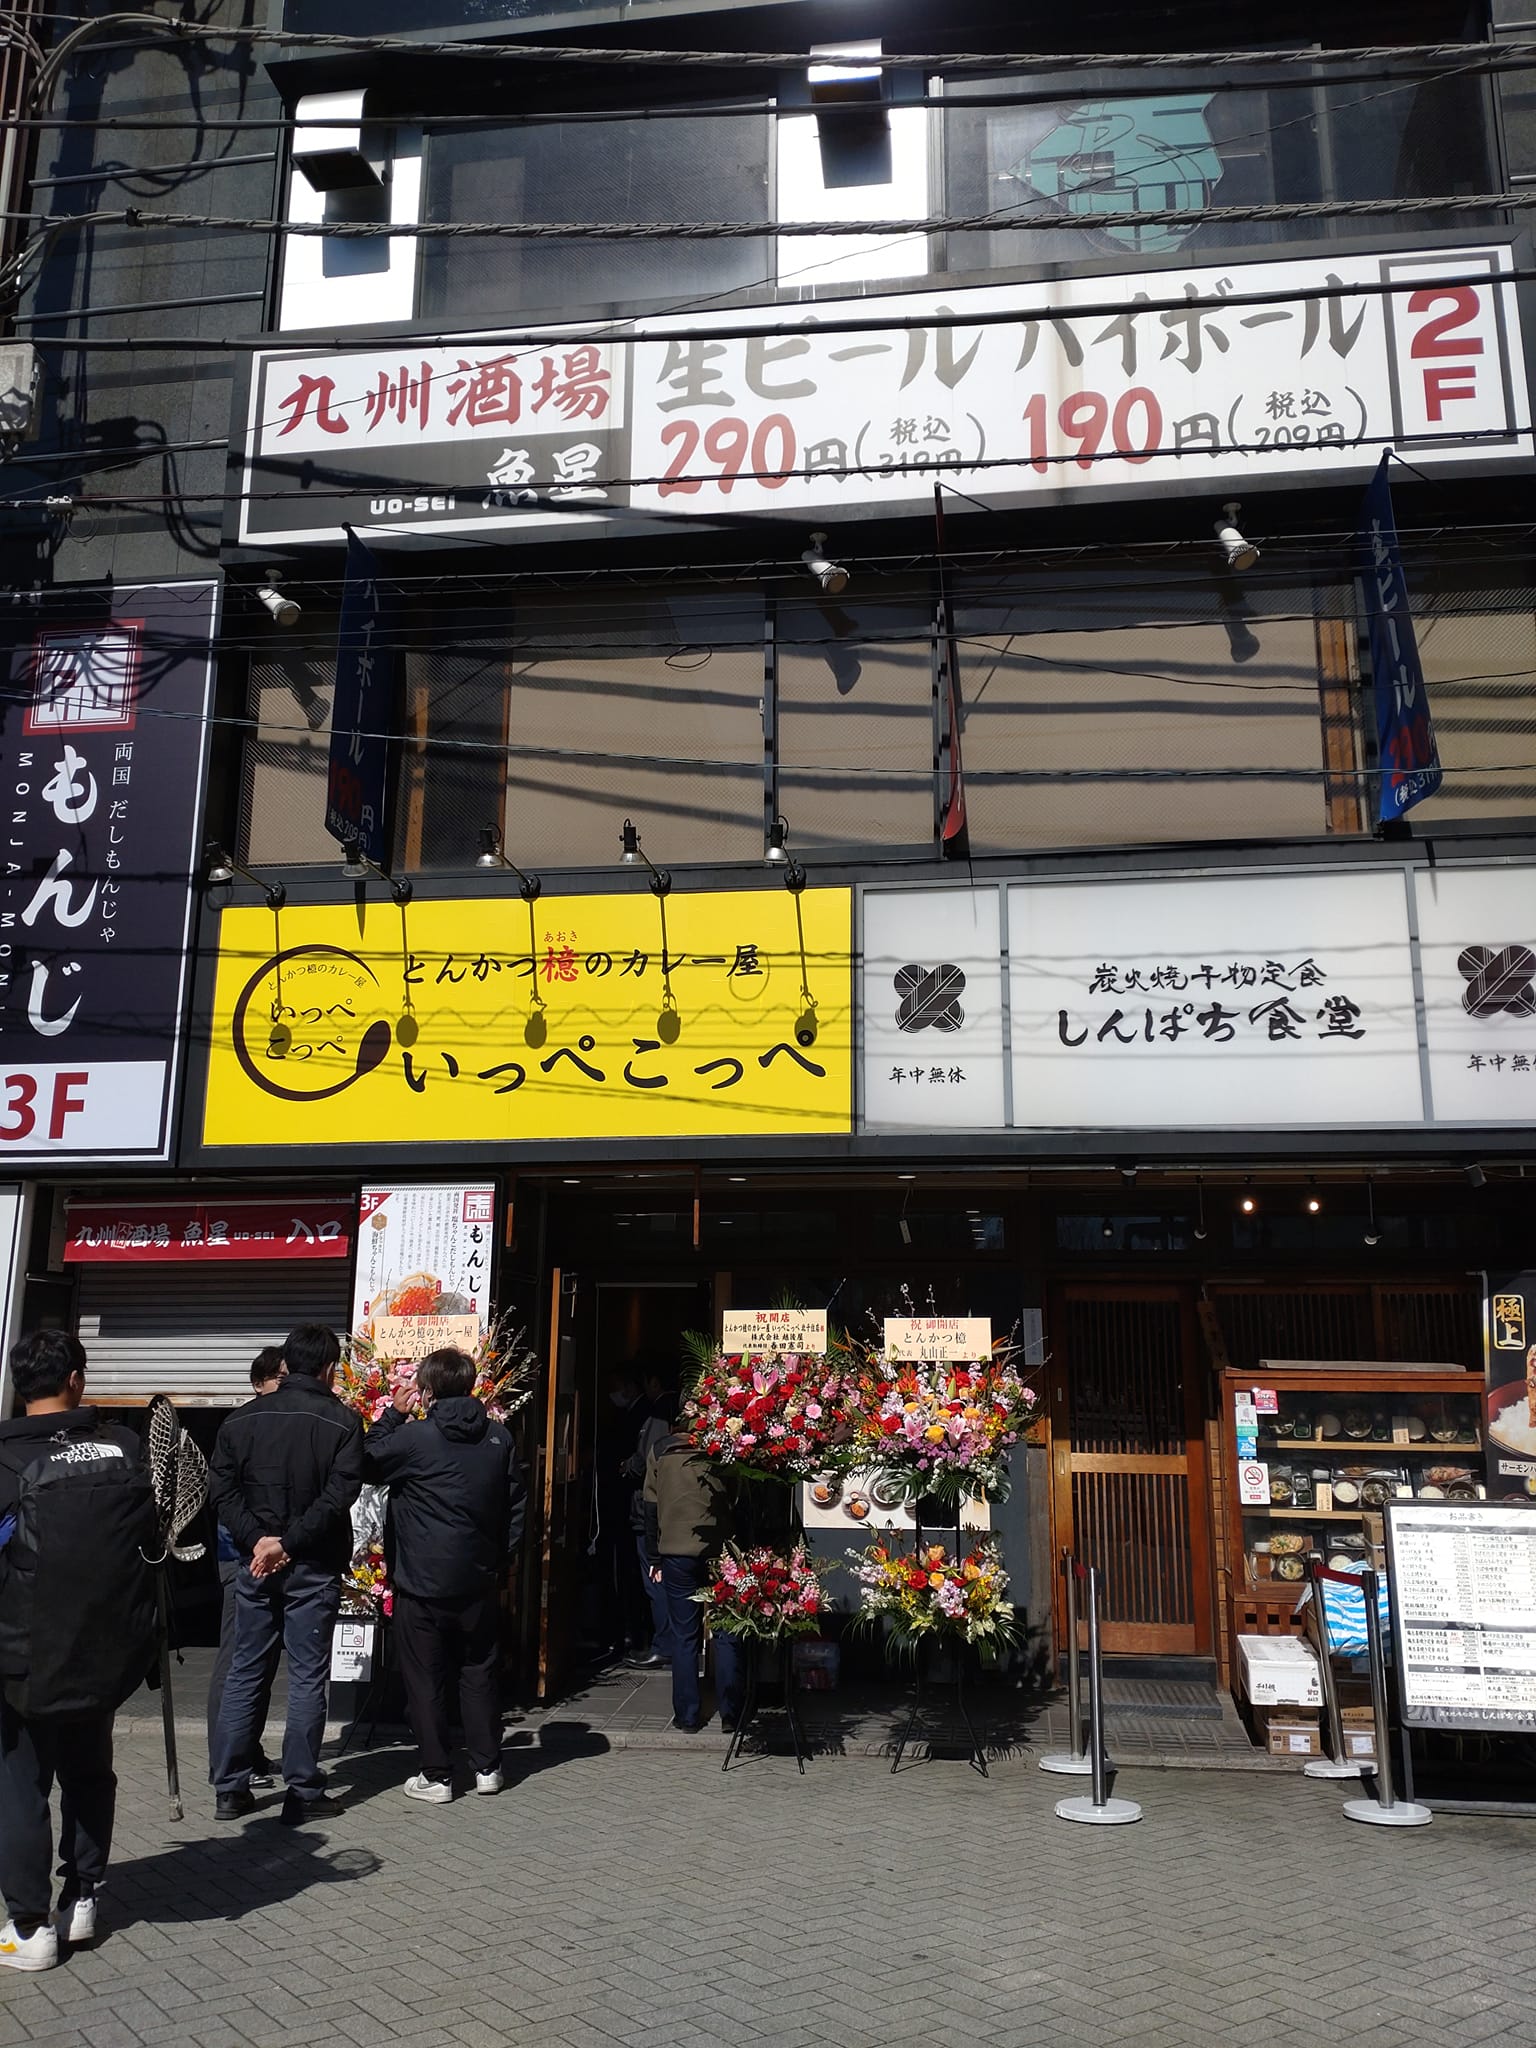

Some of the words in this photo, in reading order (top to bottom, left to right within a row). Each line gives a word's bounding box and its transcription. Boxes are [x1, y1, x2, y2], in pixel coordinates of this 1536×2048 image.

[656, 306, 983, 413] 生ビール
[1015, 273, 1367, 377] ハイボール
[1407, 285, 1485, 422] 2F
[276, 346, 611, 437] 九州酒場
[482, 443, 608, 509] 魚星
[112, 742, 134, 786] 両国
[0, 752, 33, 1033] MONJA-MON
[21, 745, 98, 1036] もんじ
[100, 800, 129, 943] だしもんじゃ
[544, 930, 578, 942] あおき
[271, 998, 356, 1024] いっぺ
[1057, 995, 1367, 1046] しんぱち食堂
[266, 1035, 346, 1061] こっぺ
[402, 1029, 826, 1094] いっぺこっぺ
[1467, 1053, 1536, 1073] 年中無
[888, 1065, 967, 1085] 年中無休
[0, 1072, 89, 1140] 3F
[360, 1194, 379, 1211] 3F
[285, 1218, 343, 1245] 入口
[467, 1224, 484, 1292] もんじ
[402, 1316, 413, 1328] 祝
[910, 1319, 922, 1331] 祝
[1496, 1298, 1523, 1346] 極上
[66, 1452, 100, 1464] FACE
